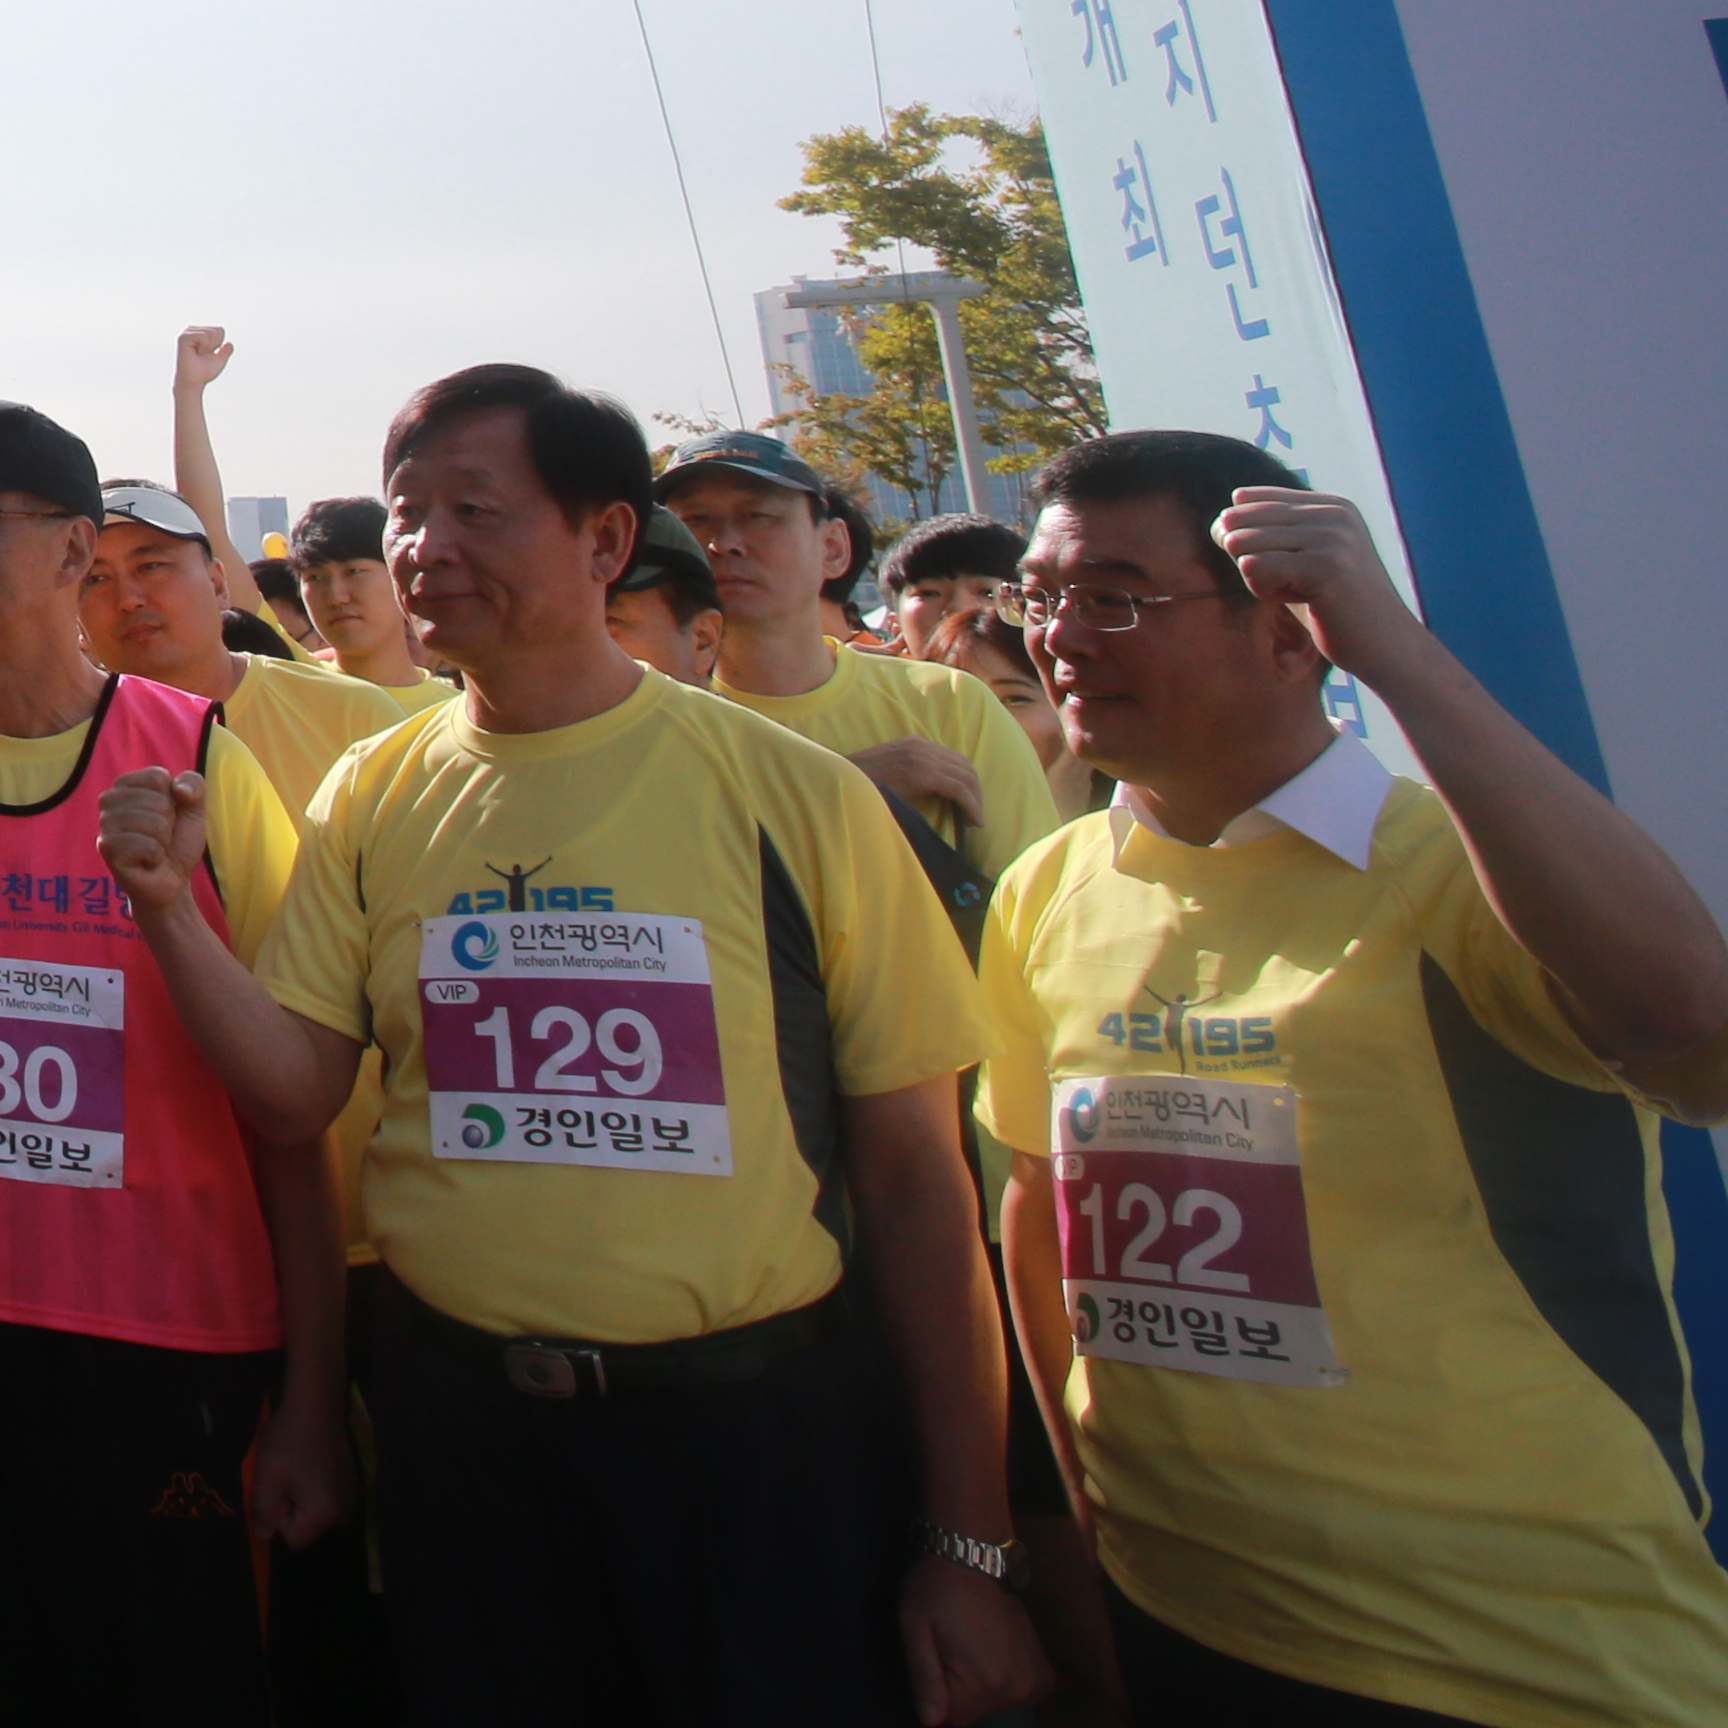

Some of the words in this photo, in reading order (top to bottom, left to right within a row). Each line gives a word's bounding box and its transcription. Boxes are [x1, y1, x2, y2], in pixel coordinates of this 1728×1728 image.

[509, 923, 663, 953] 인천광역시
[513, 955, 559, 967] Incheon
[562, 957, 640, 971] Metropolitan
[643, 957, 666, 972] City
[6, 998, 69, 1014] Metropolitan
[72, 1004, 91, 1018] City
[437, 985, 466, 1000] VIP
[474, 1005, 663, 1096] 129
[1106, 1090, 1250, 1130] 인천광역시
[516, 1107, 694, 1155] 경인일보
[1140, 1128, 1222, 1146] Metropolitan
[1226, 1132, 1254, 1150] City
[1080, 1182, 1250, 1293] 122
[1107, 1297, 1289, 1362] 경인일보
